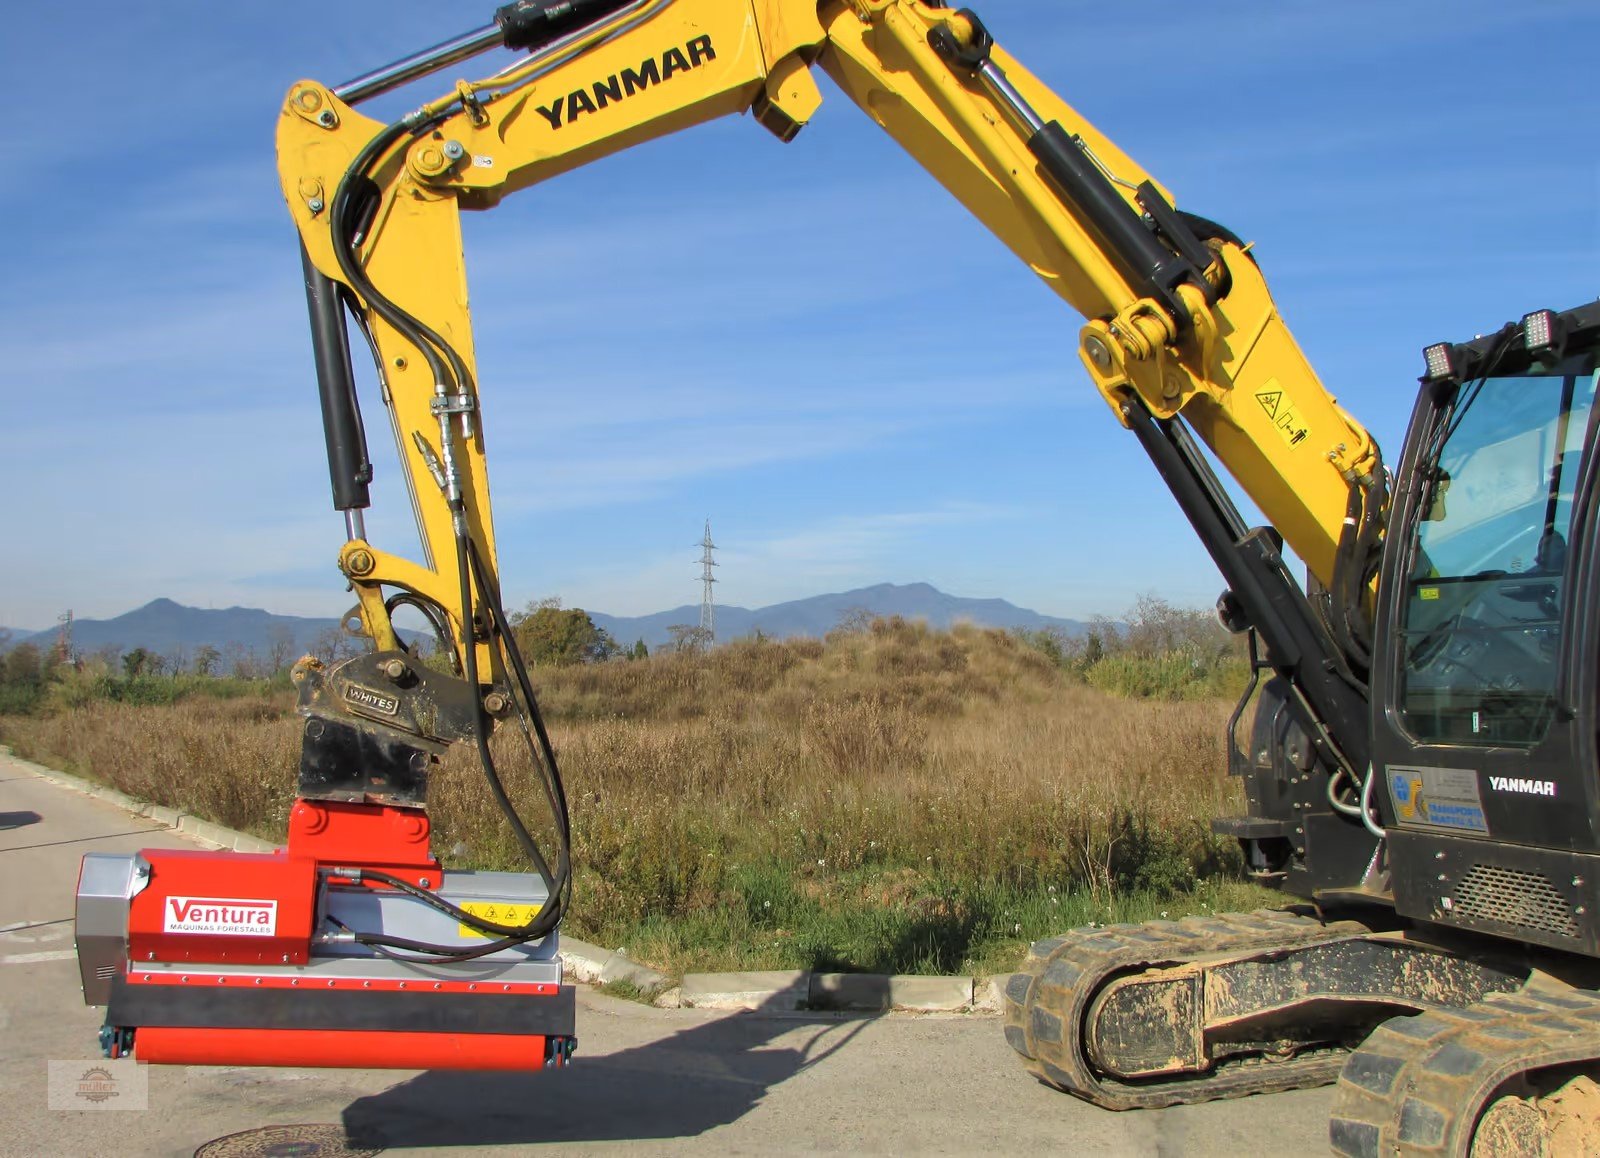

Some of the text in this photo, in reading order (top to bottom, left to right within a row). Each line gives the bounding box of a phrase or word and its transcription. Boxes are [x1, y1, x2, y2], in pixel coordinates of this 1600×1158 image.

[535, 34, 716, 130] YANMAR
[350, 689, 393, 710] WHITES
[1489, 776, 1555, 796] YANMAR
[170, 898, 271, 925] Ventura
[170, 924, 271, 934] MAQUINAS FORESTALES
